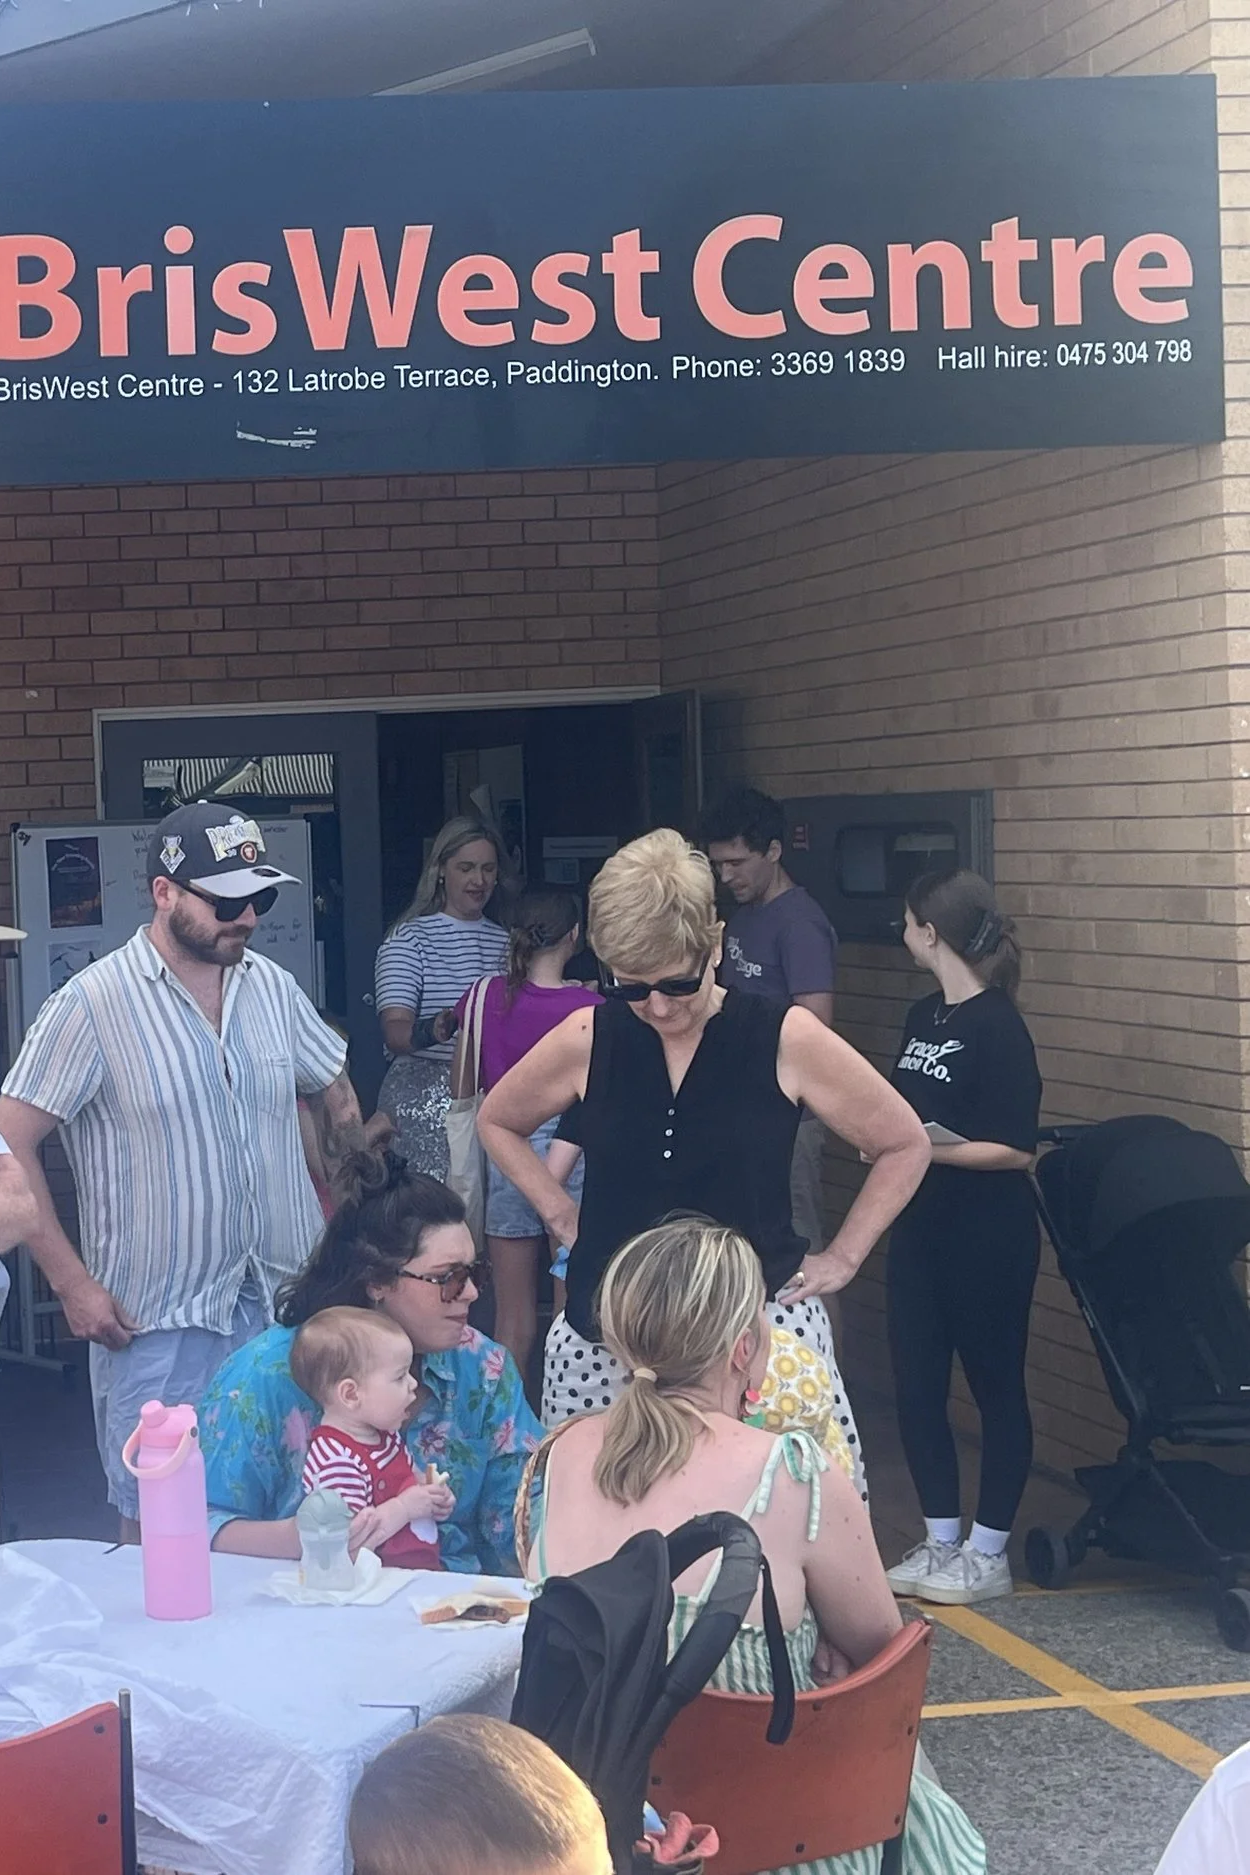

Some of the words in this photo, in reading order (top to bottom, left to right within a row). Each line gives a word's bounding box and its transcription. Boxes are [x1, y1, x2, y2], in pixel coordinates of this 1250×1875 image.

[692, 214, 1194, 340] Centre
[117, 373, 204, 398] Centre
[233, 369, 279, 394] 132
[288, 365, 386, 392] Latrobe
[393, 363, 498, 389] Terrace,
[507, 358, 659, 388] Paddington.
[672, 354, 762, 379] Phone:
[771, 350, 834, 376] 3369
[844, 348, 906, 373] 1839
[938, 345, 986, 370] Hall
[994, 344, 1048, 369] hire:
[1056, 342, 1107, 367] 0475
[1112, 340, 1149, 365] 304
[1154, 338, 1193, 363] 798
[897, 1055, 923, 1072] nce
[922, 1059, 952, 1083] Co.
